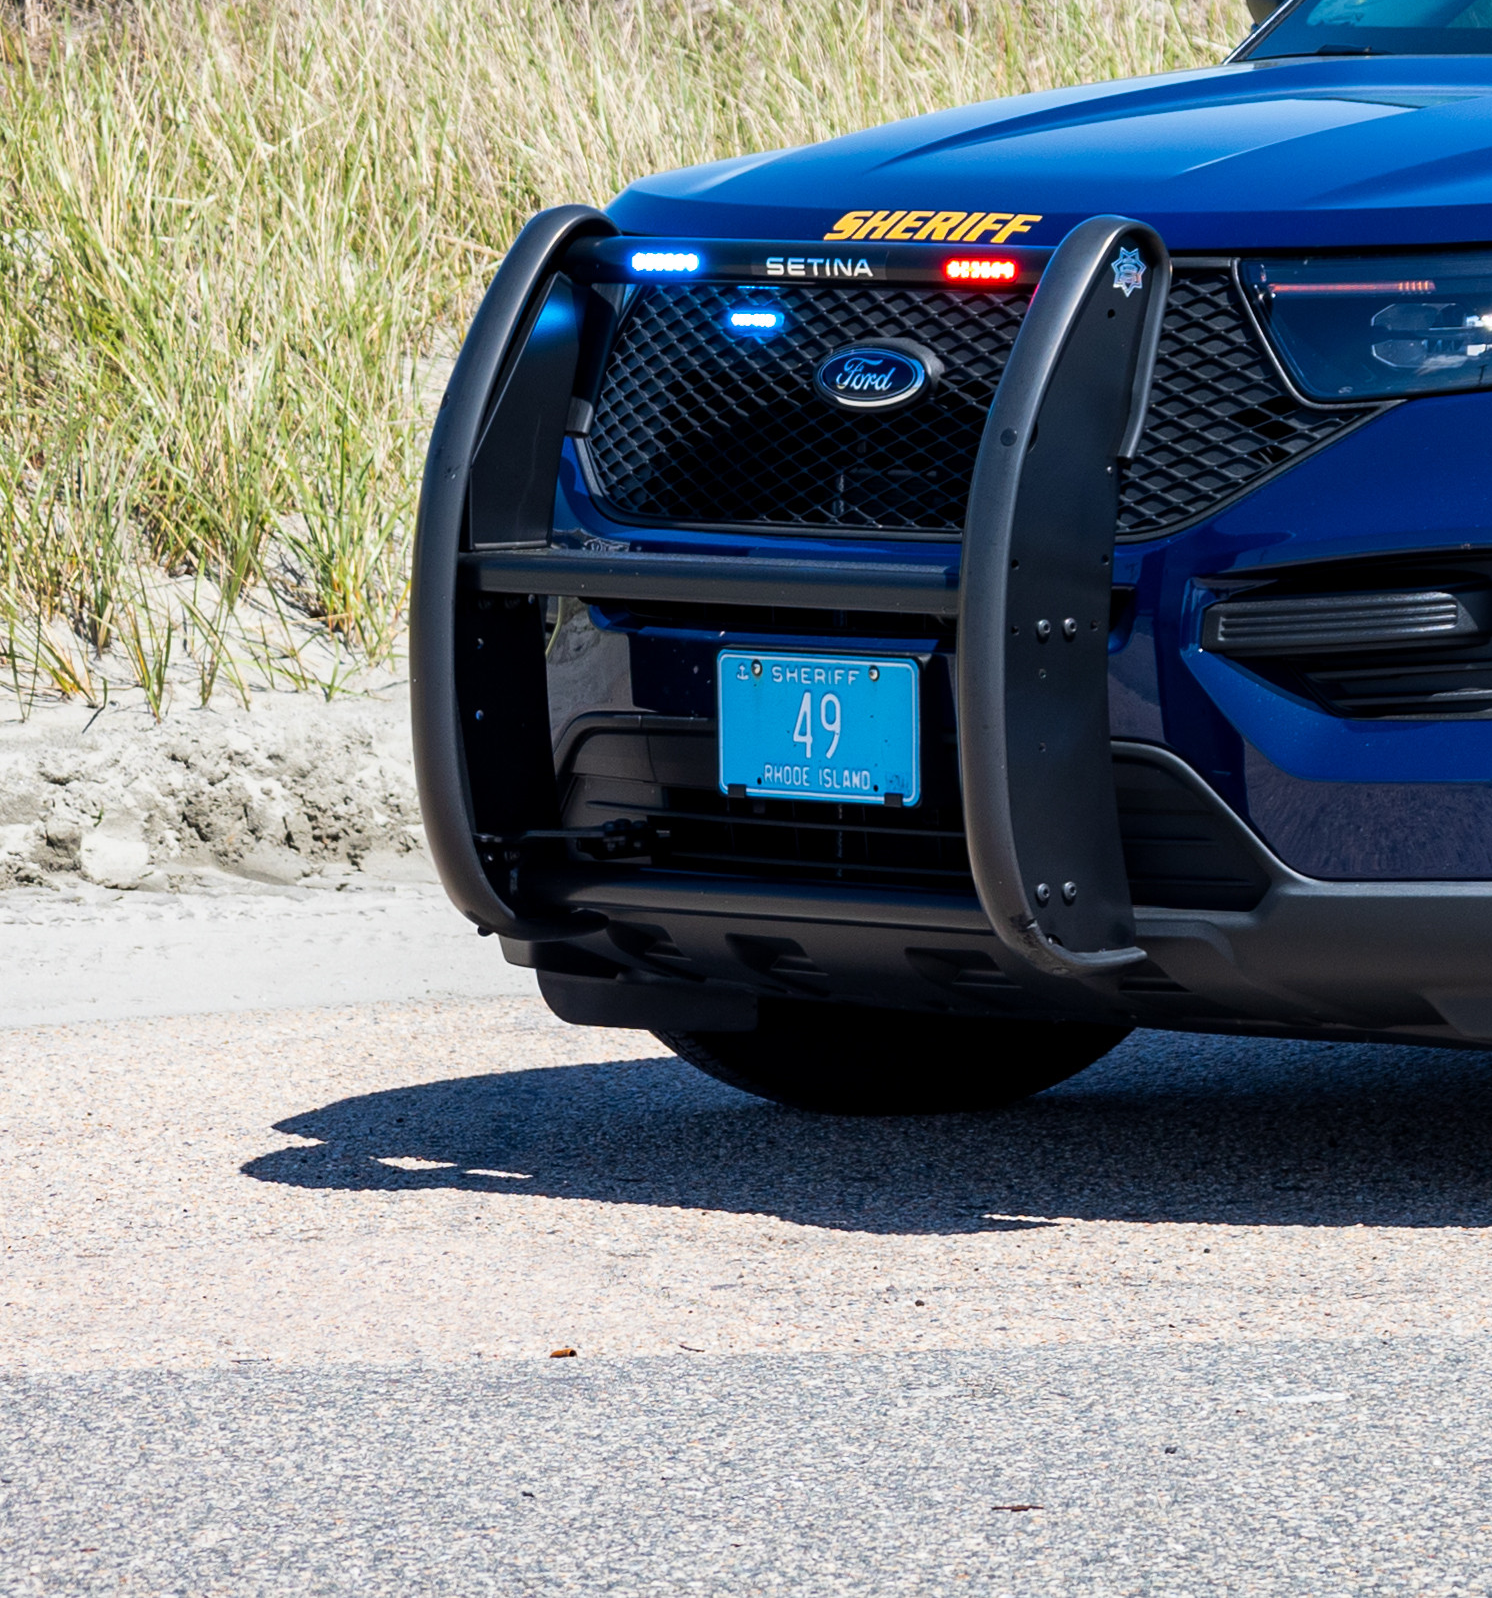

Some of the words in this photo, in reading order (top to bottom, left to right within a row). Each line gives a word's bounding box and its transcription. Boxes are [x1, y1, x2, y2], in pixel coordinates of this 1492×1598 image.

[823, 210, 1043, 244] SHERIFF
[765, 256, 874, 277] SETINA
[835, 357, 895, 391] Ford
[771, 665, 860, 685] SHERIFF
[793, 691, 841, 759] 49
[764, 764, 810, 787] RHODE
[819, 768, 871, 790] ISLAND
